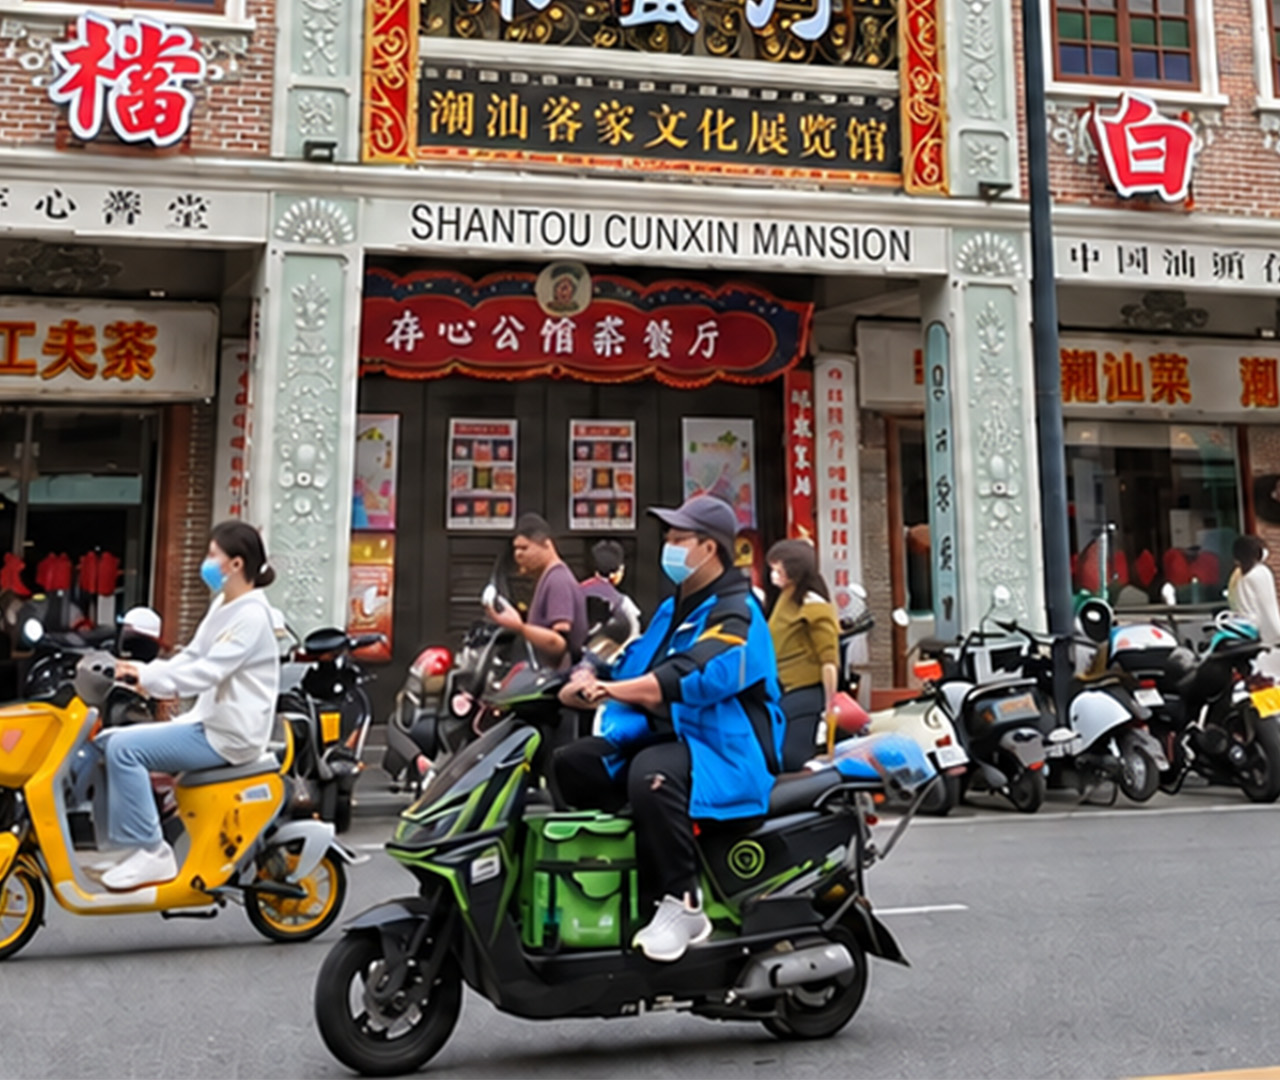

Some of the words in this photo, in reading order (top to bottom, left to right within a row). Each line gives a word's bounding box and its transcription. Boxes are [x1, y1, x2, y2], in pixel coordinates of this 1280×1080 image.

[410, 203, 592, 248] SHANTOU
[603, 213, 739, 255] CUNXIN
[752, 221, 911, 262] MANSION
